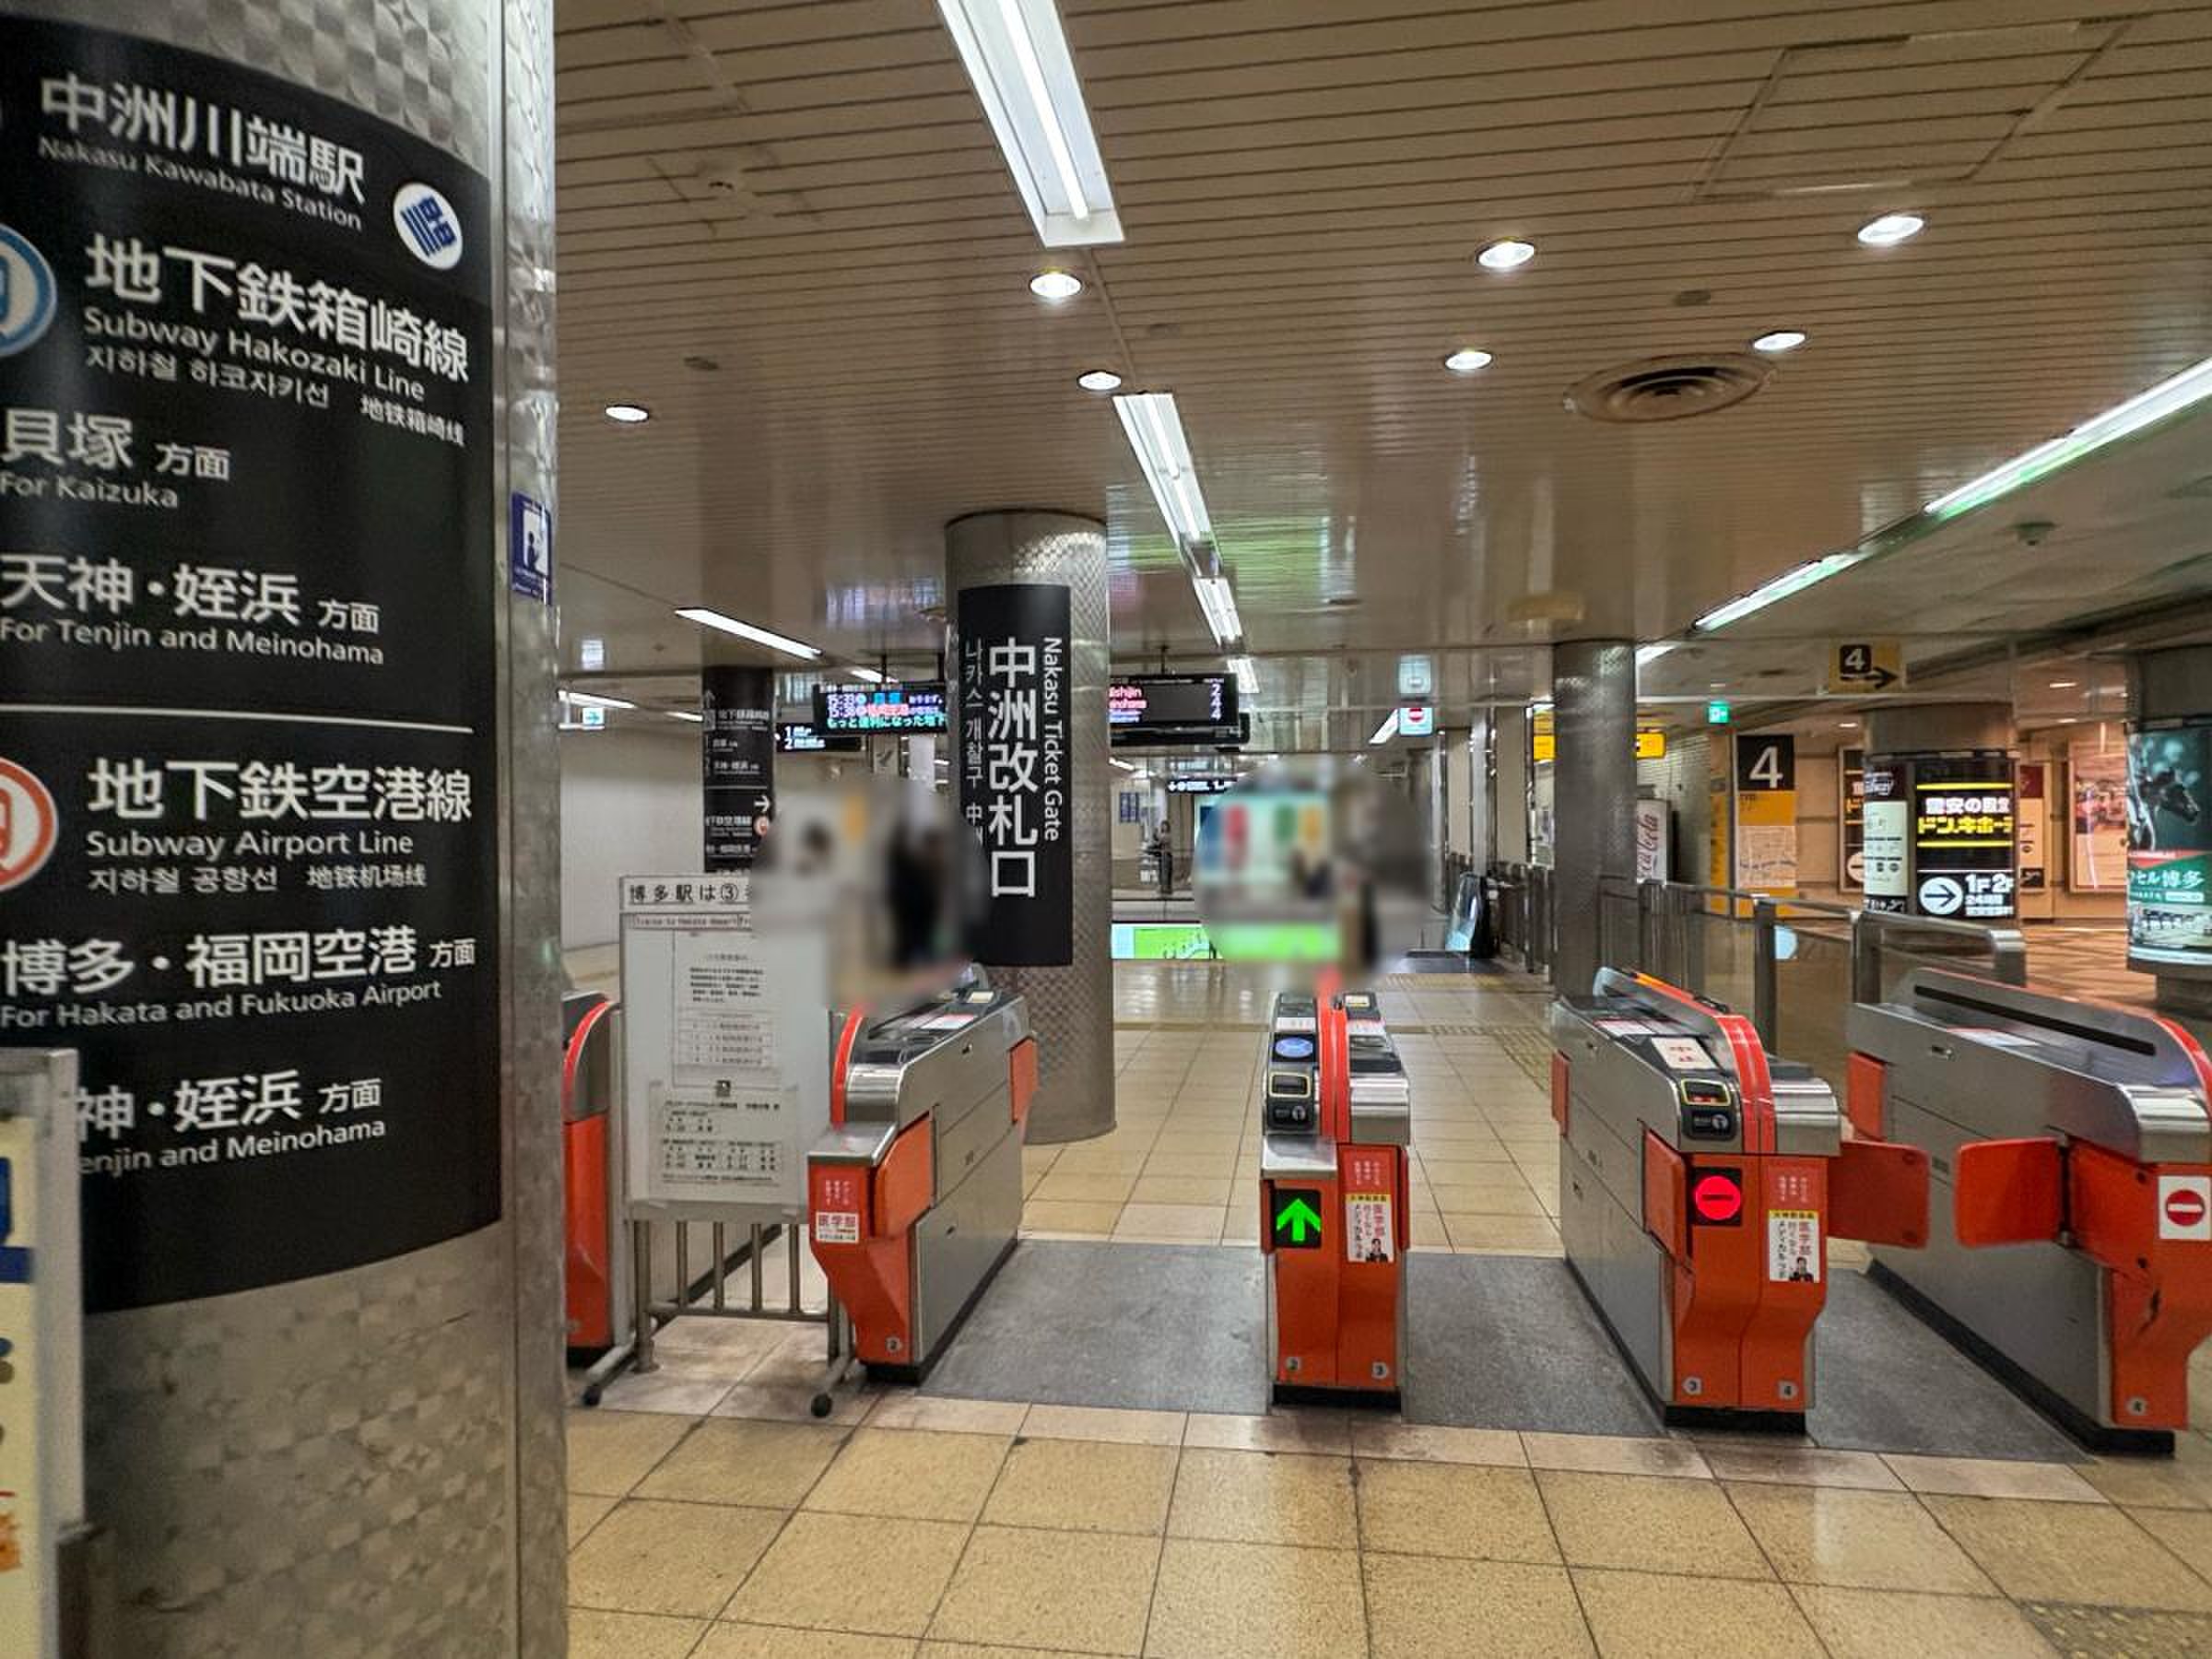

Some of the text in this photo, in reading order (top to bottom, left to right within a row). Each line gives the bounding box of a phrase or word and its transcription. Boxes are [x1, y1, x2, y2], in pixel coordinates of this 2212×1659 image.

[41, 72, 365, 204] 中洲川端駅
[39, 137, 362, 230] Nakasu Kawabata Station
[85, 233, 468, 383] 地下鉄箱崎線
[85, 307, 424, 402] Subway Hakozaki Line
[87, 345, 329, 408] 지하철 하코자키선
[3, 409, 230, 480] 貝塚 方面
[0, 474, 178, 508] For Kaizuka
[0, 618, 383, 665] For Tenjin and Meinohama
[318, 599, 380, 634] 方面
[1845, 648, 1865, 669] 4
[988, 637, 1039, 898] 中洲改札口
[1043, 637, 1063, 841] Nakasu Ticket Gate
[1748, 746, 1783, 788] 4
[88, 758, 472, 822] 地下鉄空港線
[87, 831, 413, 861] Subway Airport Line
[88, 865, 277, 894] 지하철 공항선
[1, 924, 476, 997] 博多・福岡空港 方面
[2, 980, 441, 1029] For Hakata and Fukuoka Airport
[76, 1068, 381, 1143] 神・姪浜 方面
[77, 1117, 386, 1178] enjin and Meinohama
